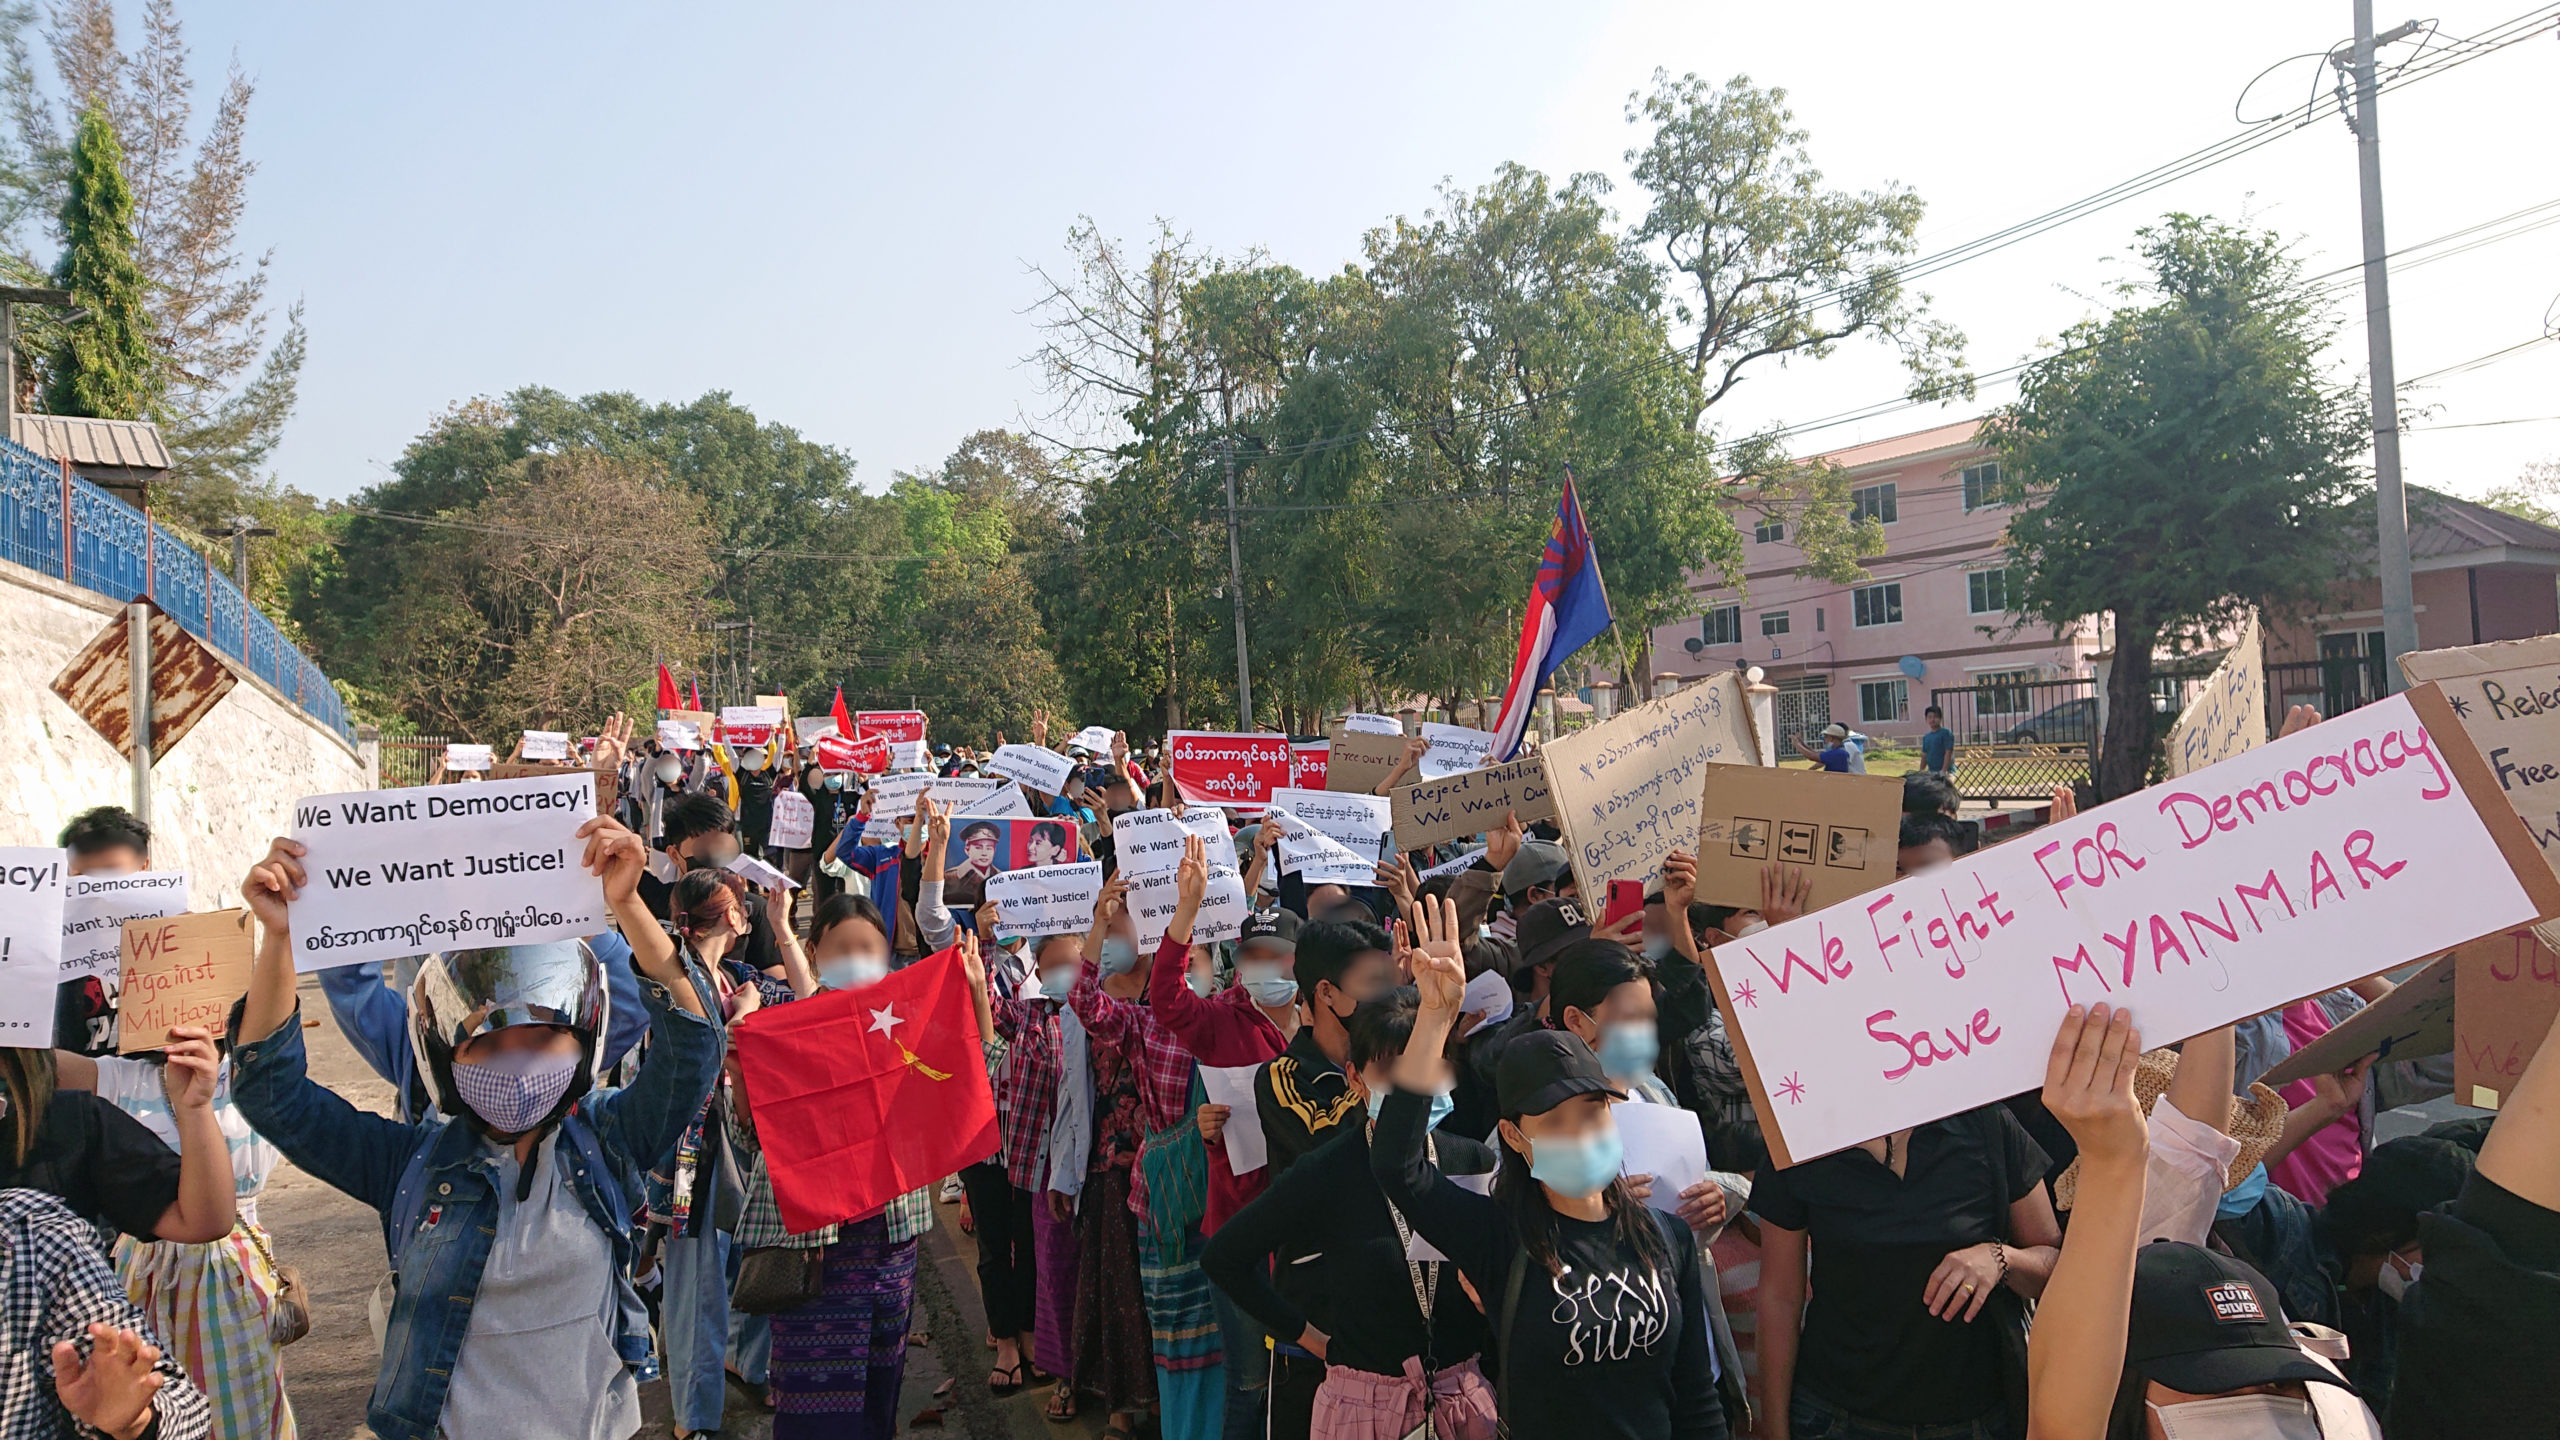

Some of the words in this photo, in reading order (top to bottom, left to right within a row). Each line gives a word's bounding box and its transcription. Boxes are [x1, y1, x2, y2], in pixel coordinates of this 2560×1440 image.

[2185, 692, 2222, 773] Fight
[1174, 742, 1288, 768] စစ်အာဏာရှင်စနစ်
[1334, 744, 1358, 762] Free
[1016, 754, 1034, 764] Want
[1034, 760, 1060, 774] Justice!
[2489, 747, 2560, 791] Free
[889, 791, 906, 799] Want
[955, 780, 994, 790] Democracy!
[1411, 776, 1470, 804] Reject
[297, 806, 331, 828] We
[342, 800, 417, 824] Want
[428, 784, 590, 818] Democracy!
[1268, 810, 1286, 820] We
[1414, 808, 1450, 826] We
[1462, 788, 1511, 814] Want
[1116, 819, 1130, 830] We
[1134, 814, 1163, 826] Want
[1166, 810, 1223, 824] Dmocracy!
[1130, 844, 1146, 854] We
[1150, 840, 1178, 851] Want
[1287, 832, 1304, 842] We
[326, 867, 371, 889] We
[381, 859, 454, 884] Want
[464, 850, 565, 877] Justice!
[1747, 920, 1853, 995] We
[1866, 872, 2016, 980] Fight
[2034, 821, 2147, 911] FOR
[2158, 724, 2451, 850] Democracy
[78, 876, 183, 895] Democracy!
[989, 876, 1004, 886] We
[1008, 872, 1036, 881] Want
[1038, 865, 1099, 878] Democracy!
[1142, 876, 1170, 889] Want
[1002, 899, 1018, 908] We
[1022, 895, 1048, 906] Want
[1051, 891, 1090, 904] Justice!
[1140, 908, 1156, 918] We
[1251, 924, 1276, 932] adidas
[129, 924, 179, 961] WE
[1864, 1006, 2002, 1081] Save
[2053, 828, 2409, 1007] MYANMAR
[123, 952, 216, 1004] Against
[2212, 1290, 2252, 1302] QUIK
[2217, 1302, 2260, 1315] SILVER
